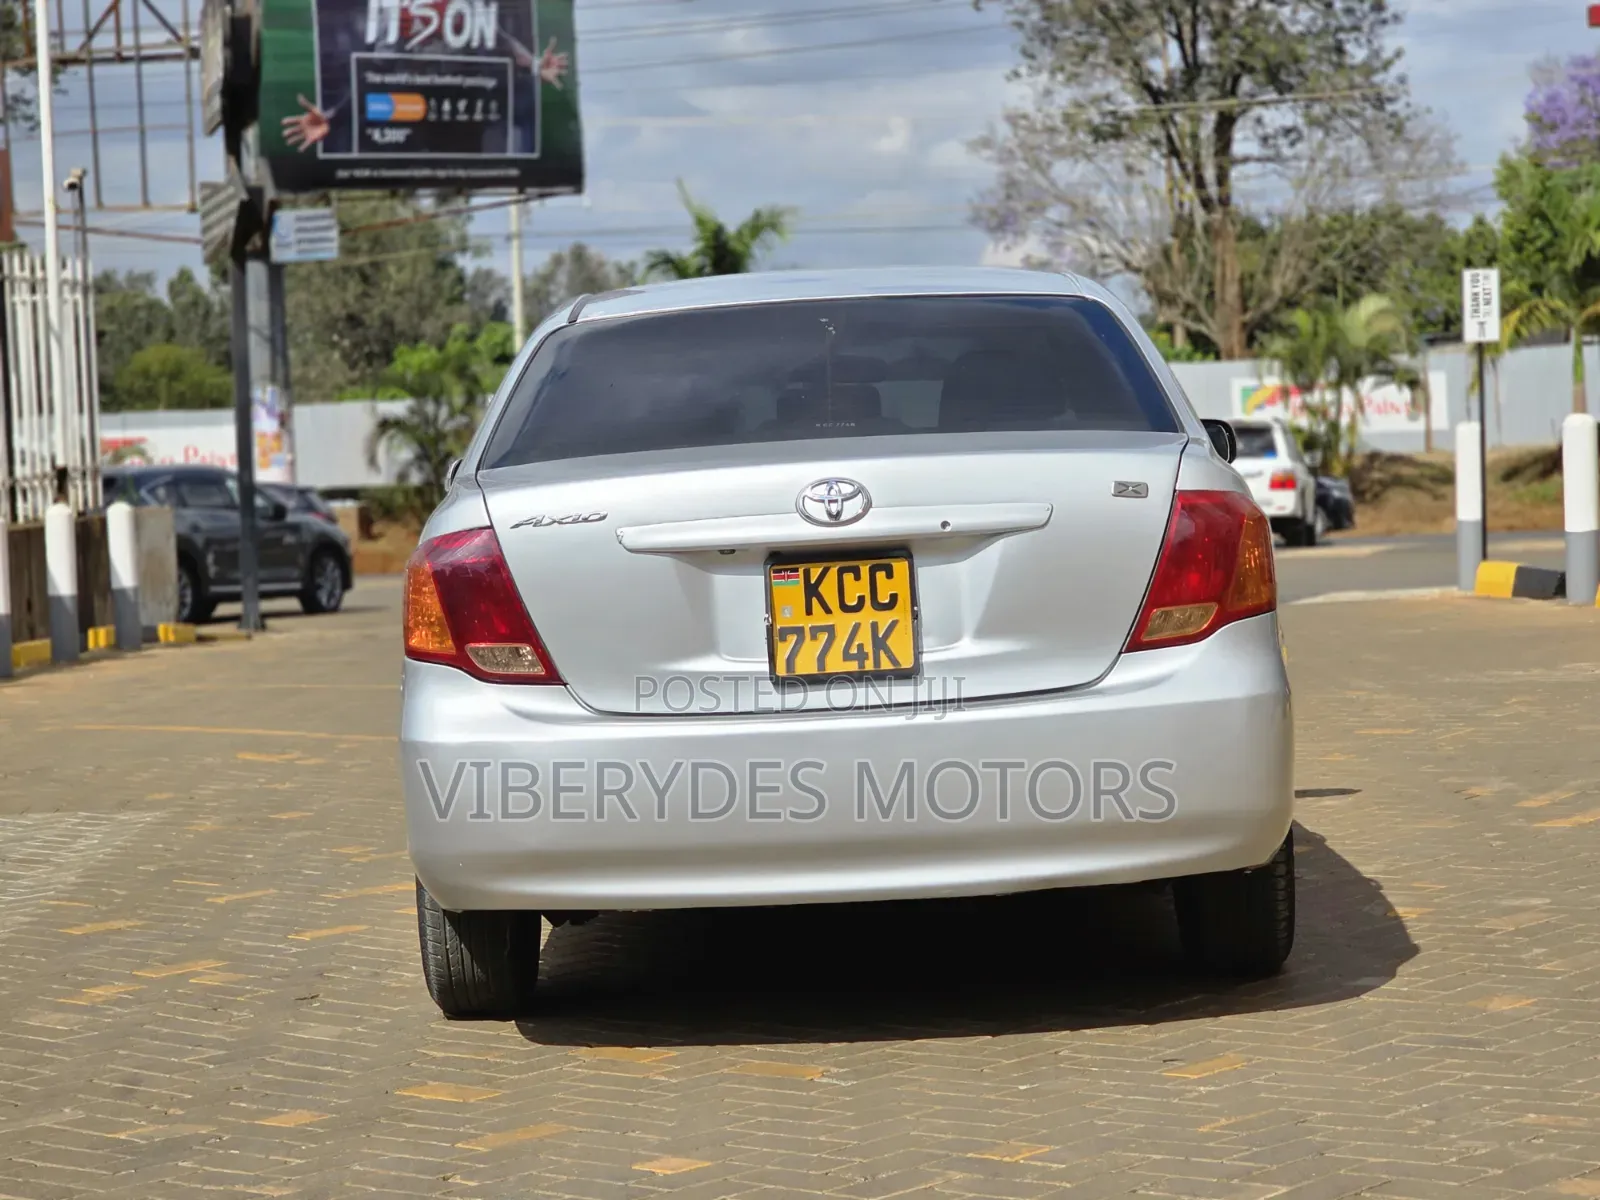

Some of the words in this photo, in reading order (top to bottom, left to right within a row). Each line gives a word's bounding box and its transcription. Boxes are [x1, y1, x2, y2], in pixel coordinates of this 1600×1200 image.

[443, 0, 499, 50] ON
[1470, 272, 1481, 288] YOU
[1470, 292, 1481, 319] THANK
[1482, 287, 1492, 306] NEXT
[509, 511, 609, 529] AXIO
[802, 562, 899, 616] KCC
[777, 618, 902, 674] 774K
